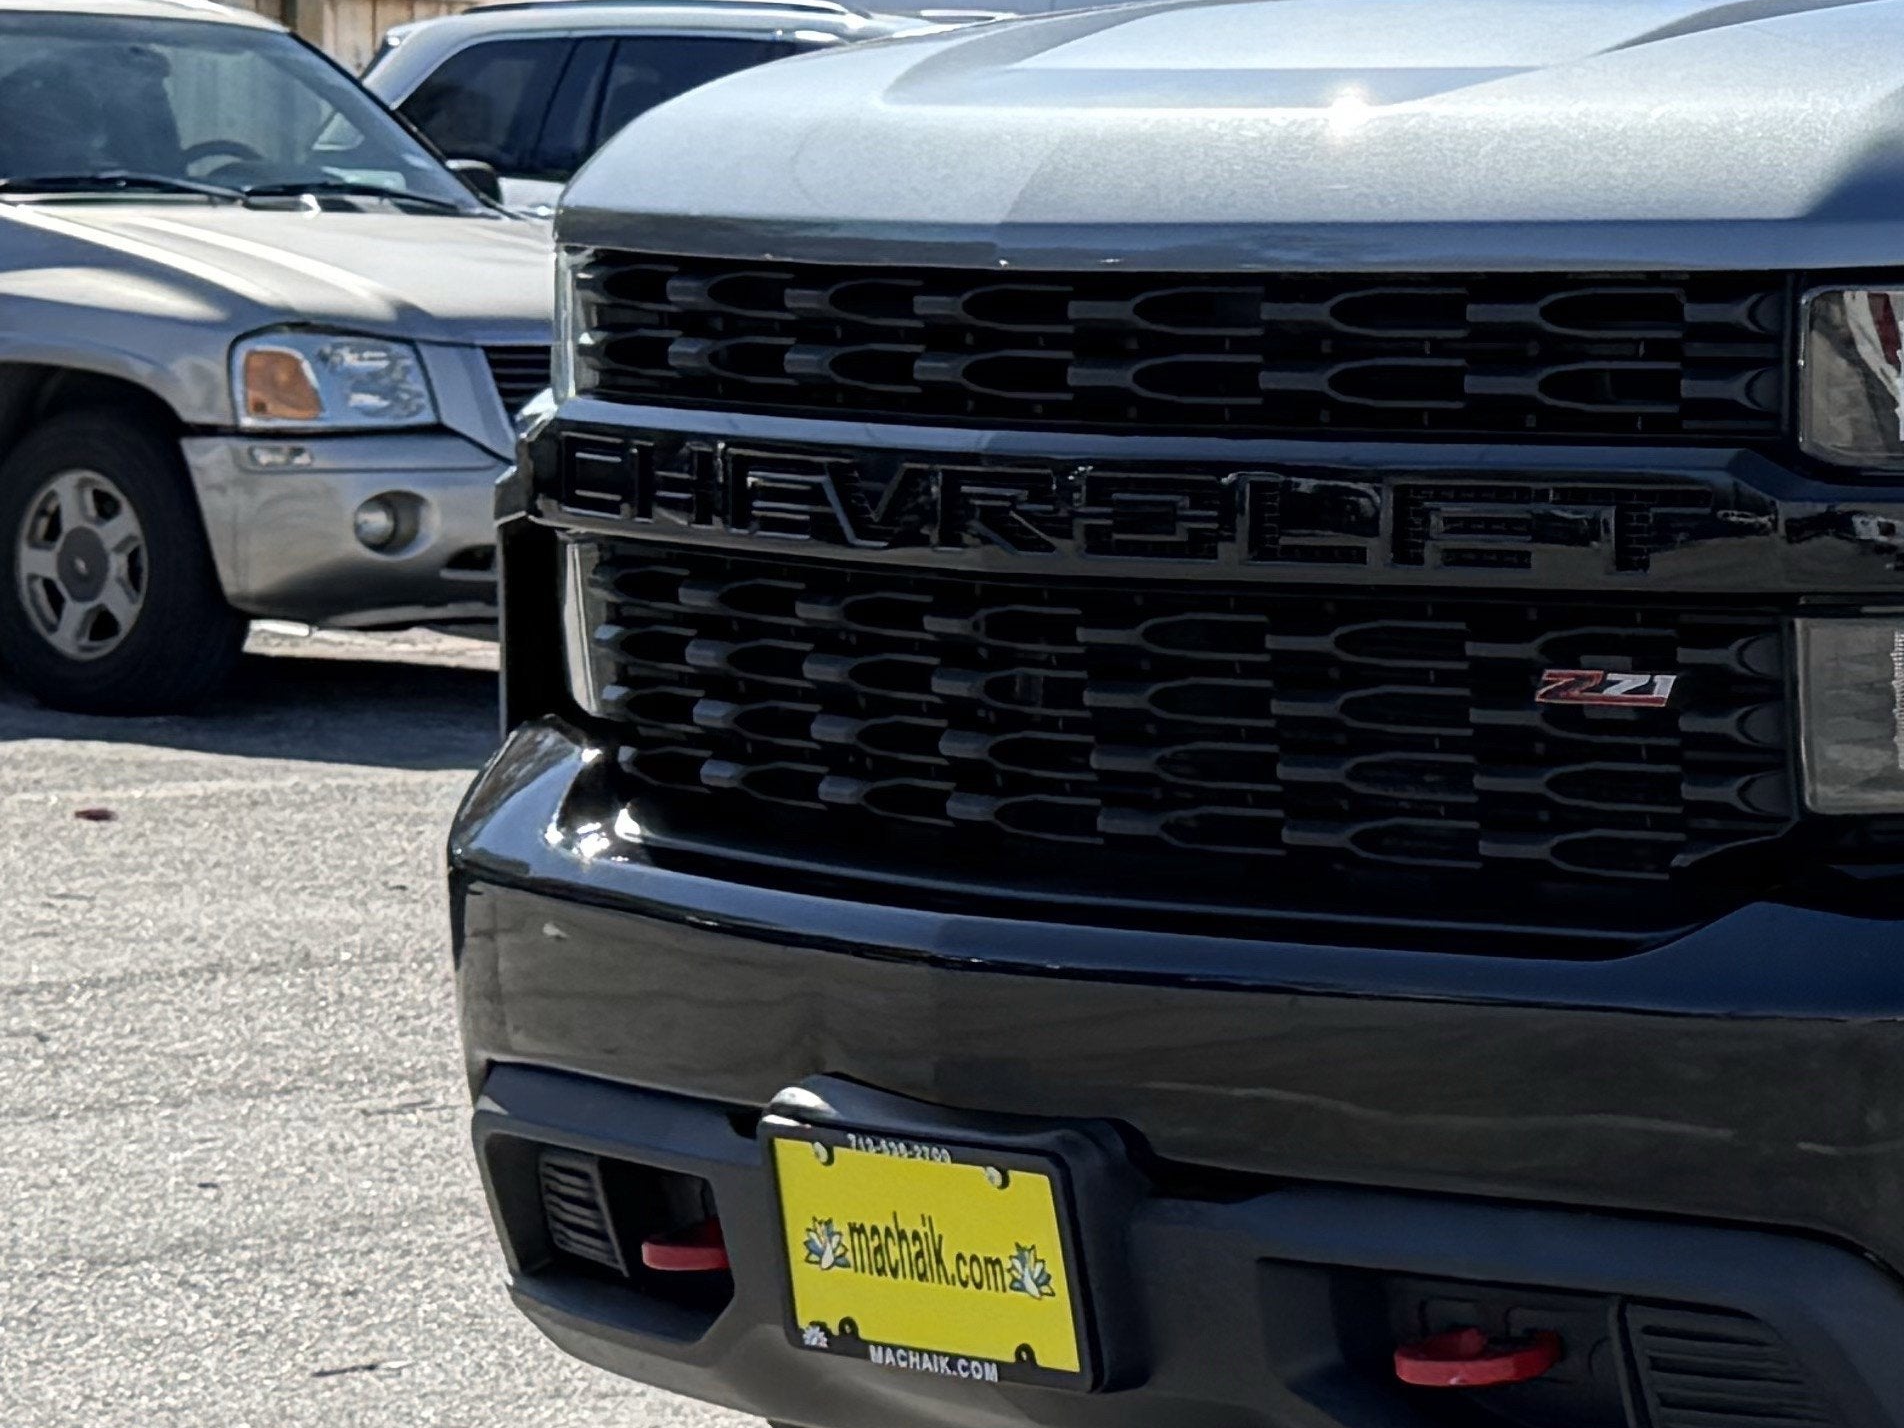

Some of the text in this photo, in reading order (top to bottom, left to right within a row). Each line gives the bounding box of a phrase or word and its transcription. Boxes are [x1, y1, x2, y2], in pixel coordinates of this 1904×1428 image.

[560, 432, 1713, 573] CHEVROLET
[1535, 669, 1677, 708] Z71
[847, 1210, 1008, 1293] machaik.com
[869, 1344, 999, 1383] MACHAIK.COM
